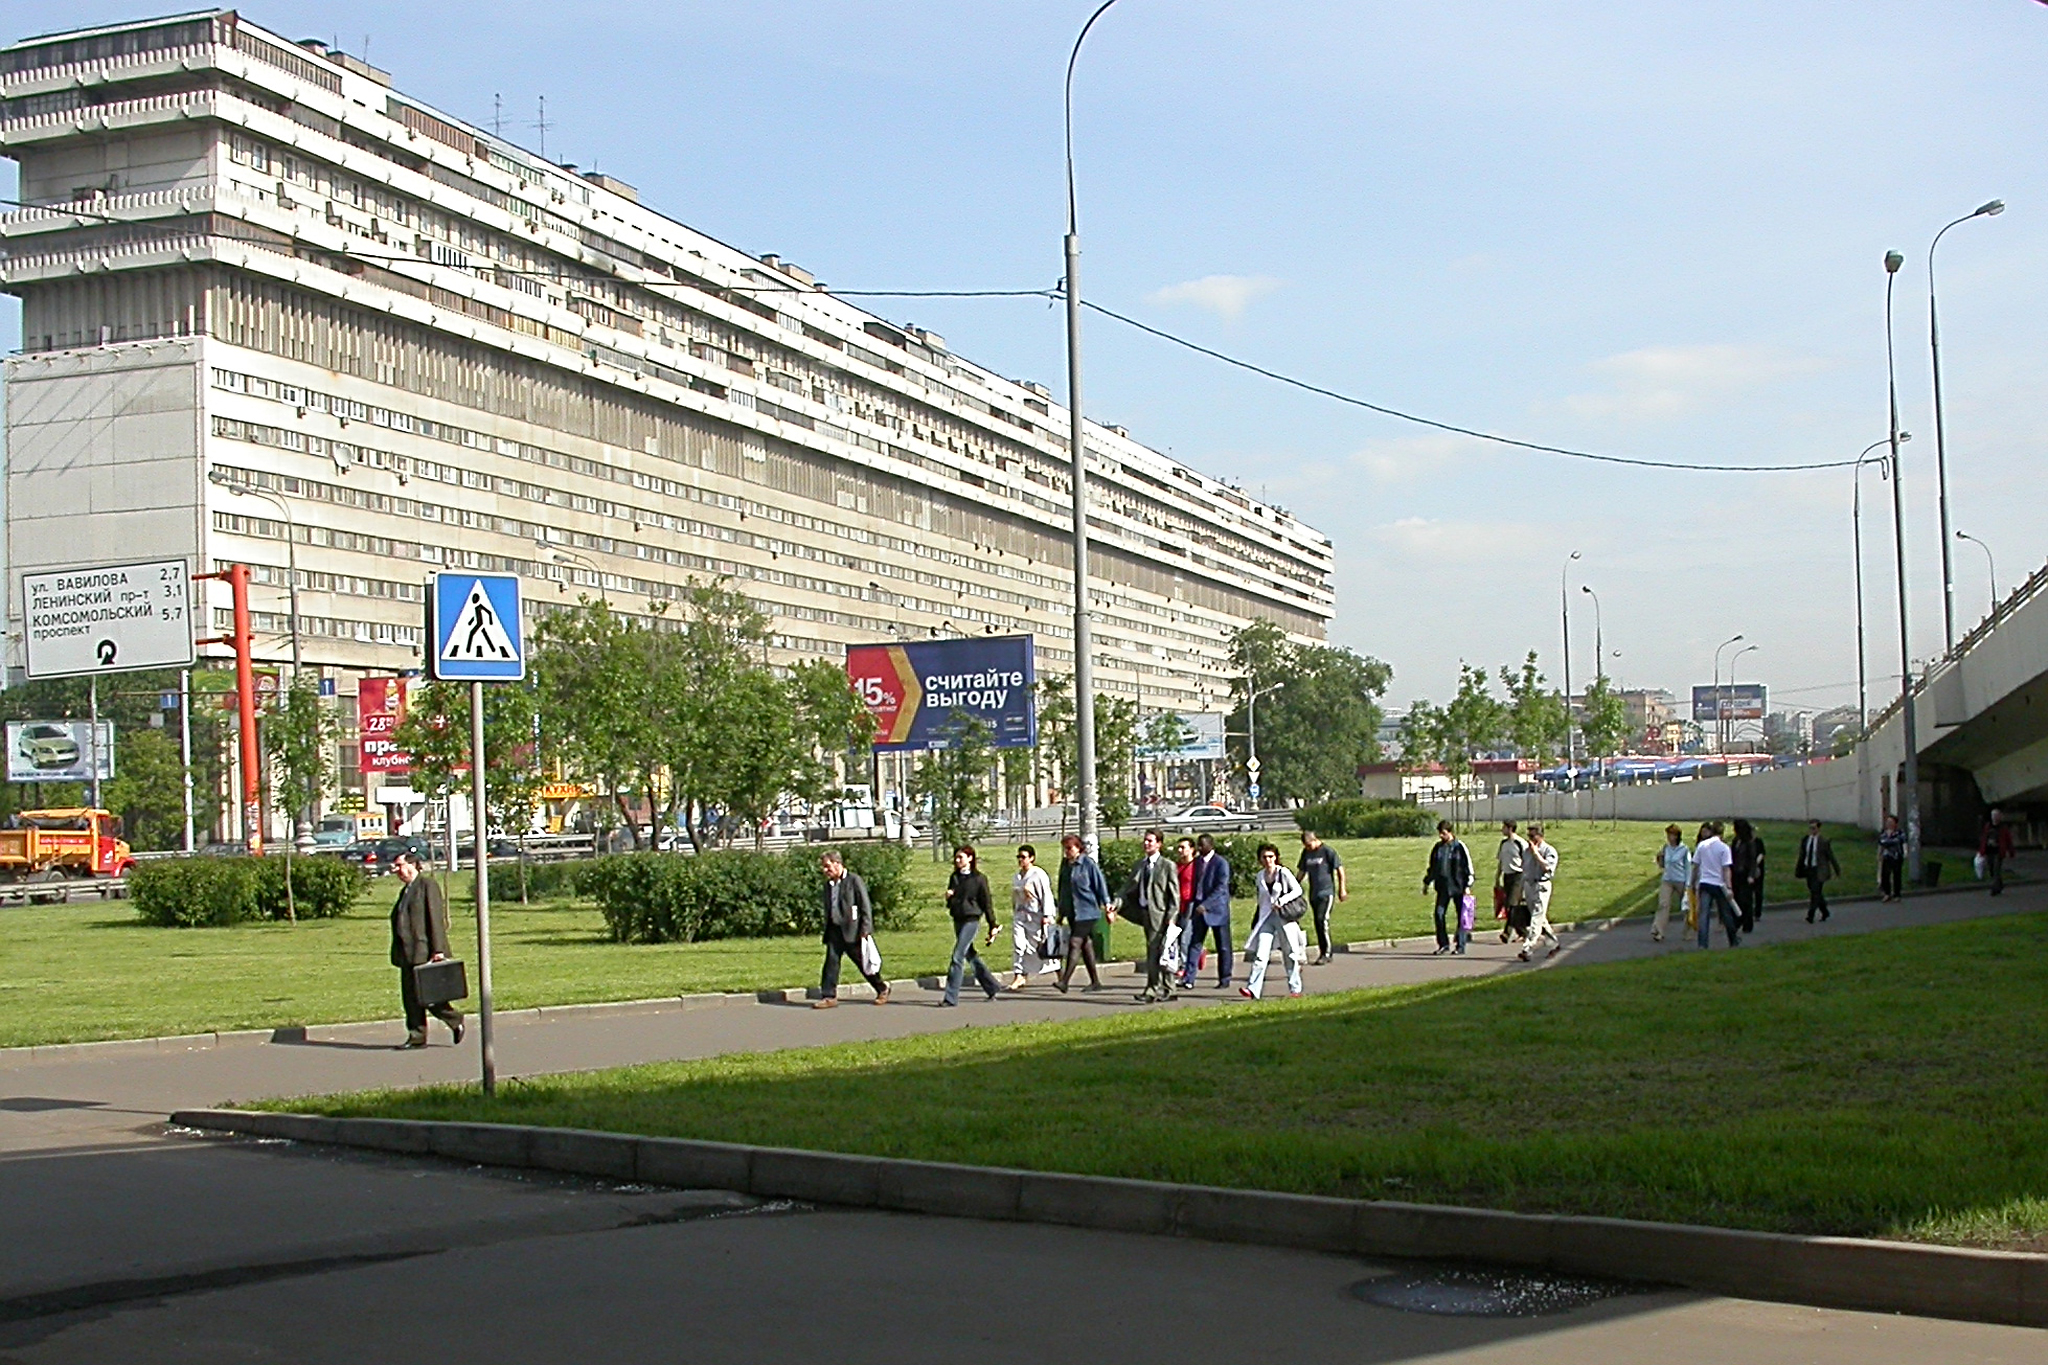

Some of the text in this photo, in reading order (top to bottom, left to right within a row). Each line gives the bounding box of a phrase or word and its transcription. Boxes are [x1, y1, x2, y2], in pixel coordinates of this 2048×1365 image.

[31, 567, 180, 597] ул. ВАВИЛОВА 2,7
[32, 584, 182, 610] ЛЕНИНСКИЙ пр-т 3,1
[32, 601, 182, 627] КОМСОМОЛЬСКИЙ 5,7
[33, 625, 91, 641] проспект
[925, 668, 1023, 690] считайте
[926, 689, 1009, 710] выгоду
